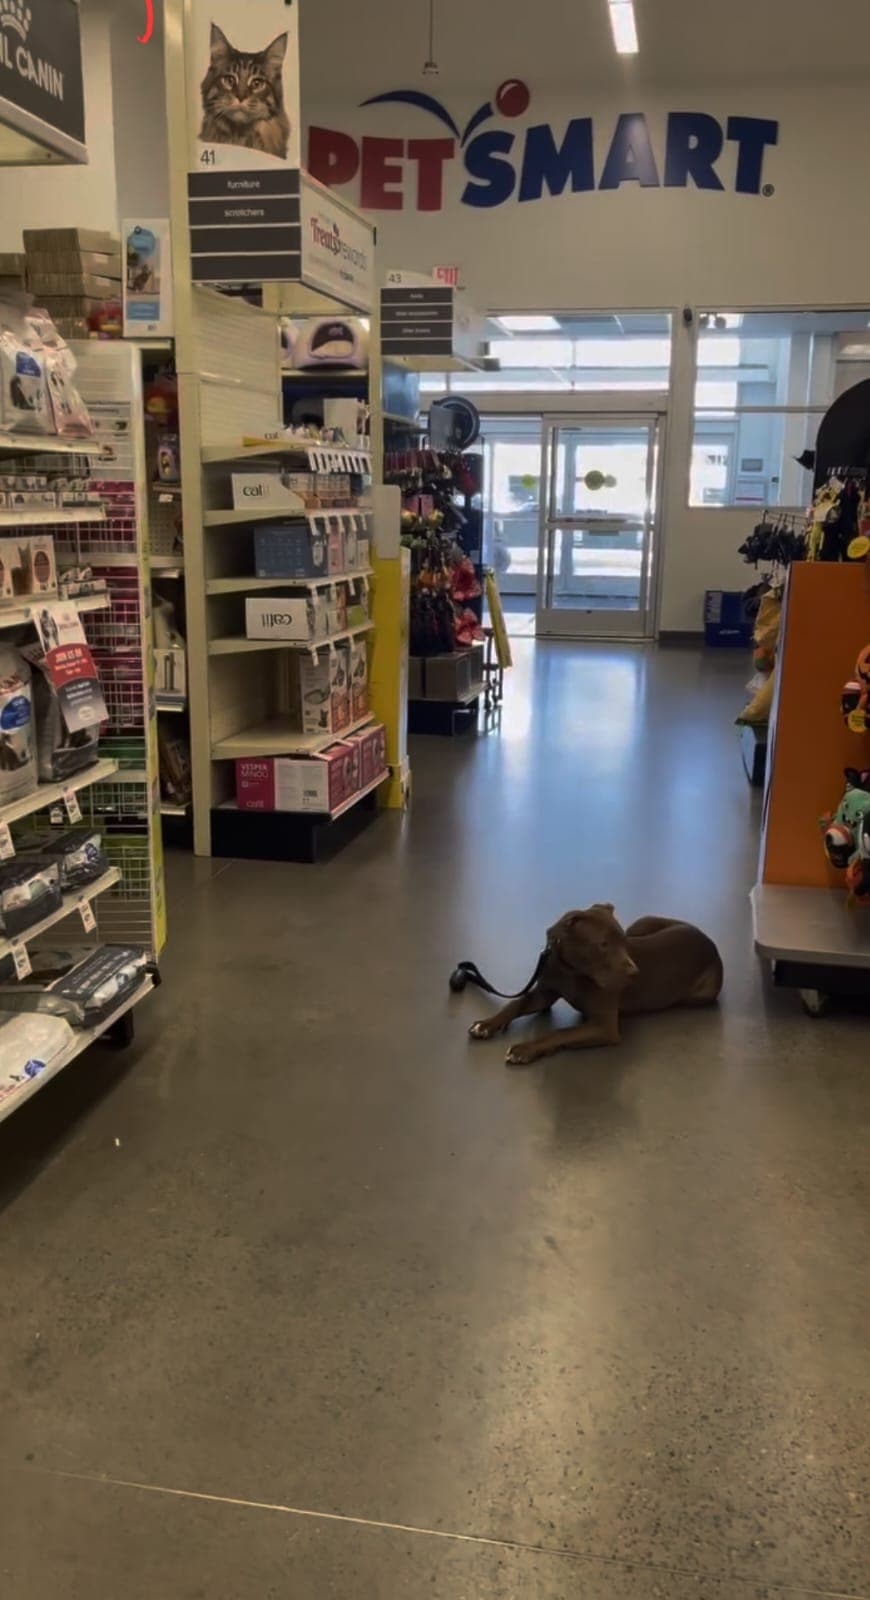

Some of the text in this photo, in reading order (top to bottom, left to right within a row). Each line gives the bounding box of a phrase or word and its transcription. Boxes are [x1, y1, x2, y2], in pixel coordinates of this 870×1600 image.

[16, 45, 64, 101] CANIN
[200, 150, 216, 165] 41
[227, 181, 260, 189] furniture
[389, 273, 402, 284] 43
[241, 763, 268, 771] VESPER
